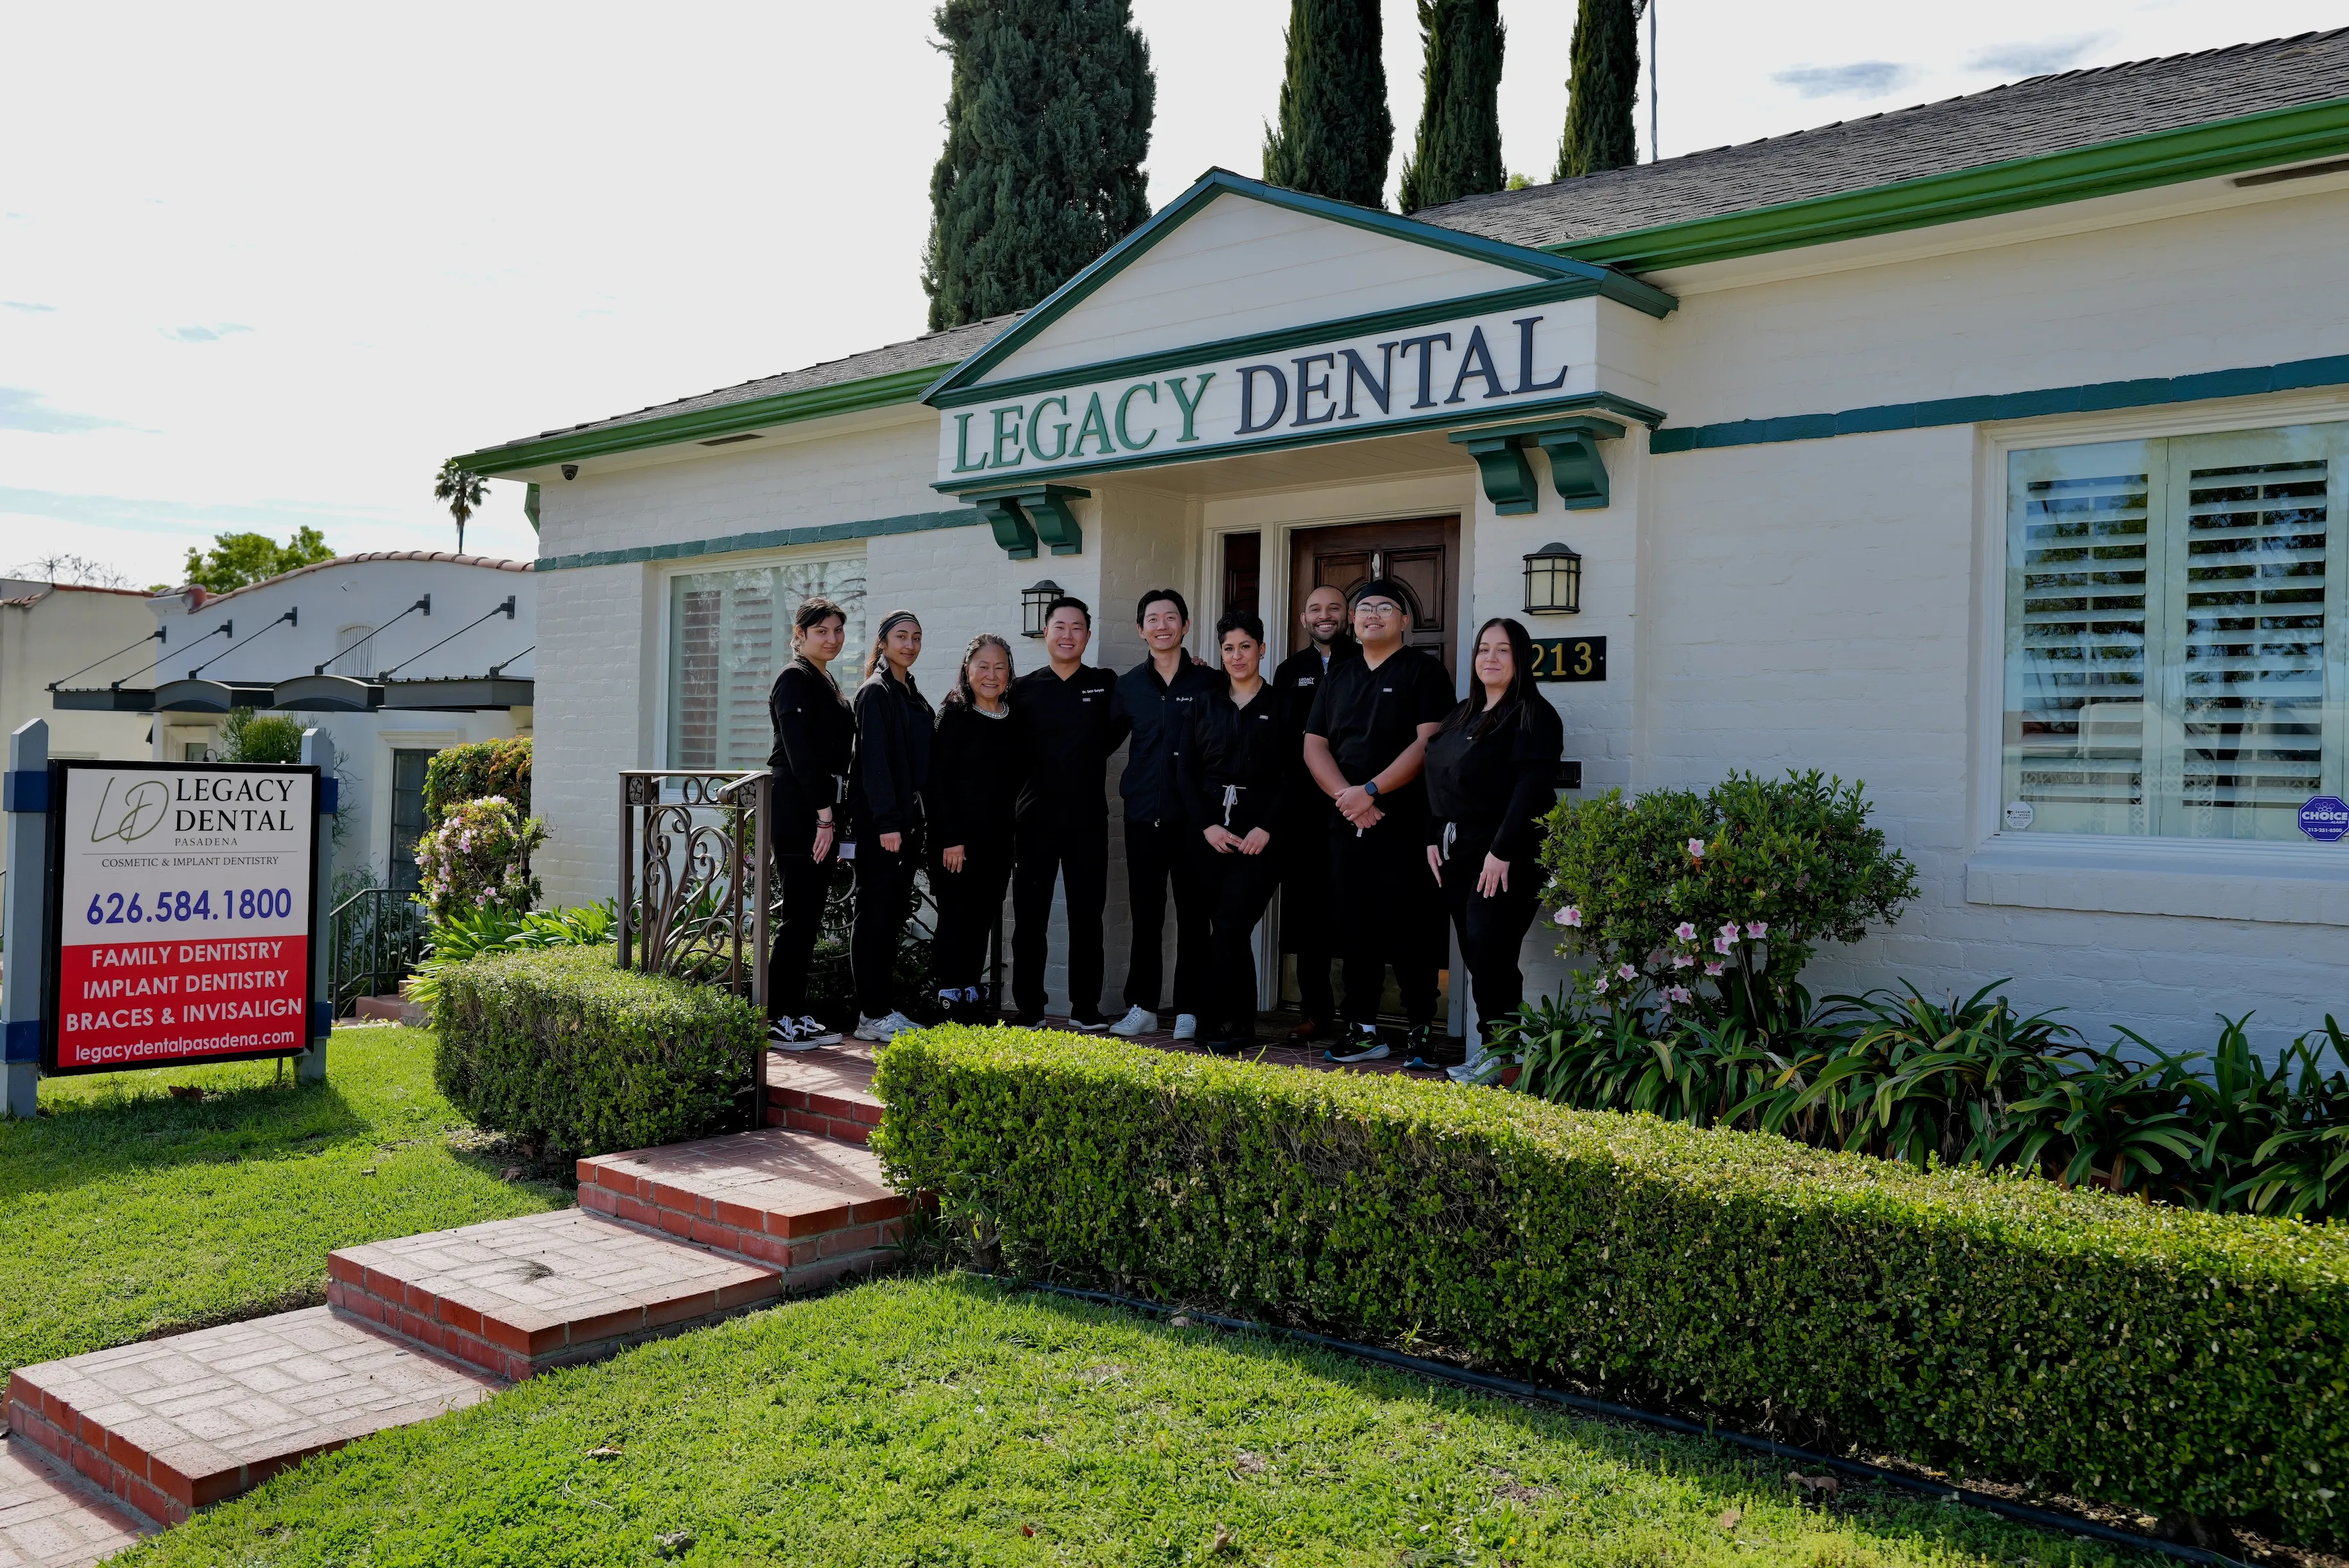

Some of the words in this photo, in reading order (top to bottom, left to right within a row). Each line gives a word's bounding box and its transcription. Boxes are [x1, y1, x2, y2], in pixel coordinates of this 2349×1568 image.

[951, 372, 1216, 473] LEGACY
[1234, 316, 1568, 435] DENTAL
[175, 778, 295, 802] LEGACY
[175, 809, 294, 831] DENTAL
[2302, 811, 2348, 821] CHOICE
[175, 838, 238, 846] PASADENA
[101, 858, 159, 868] COSMETIC
[162, 858, 169, 866] &
[173, 857, 220, 866] IMPLANT
[223, 856, 279, 865] DENTISTRY
[87, 888, 291, 924] 626.584.1800
[92, 947, 172, 967] FAMILY
[179, 942, 283, 963] DENTISTRY
[83, 976, 178, 999] IMPLANT
[185, 970, 289, 993] DENTISTRY
[66, 1008, 153, 1031] BRACES
[162, 1007, 176, 1024] &
[184, 998, 302, 1022] INVISALIGN
[76, 1031, 295, 1064] legacydentalpasadena.com
